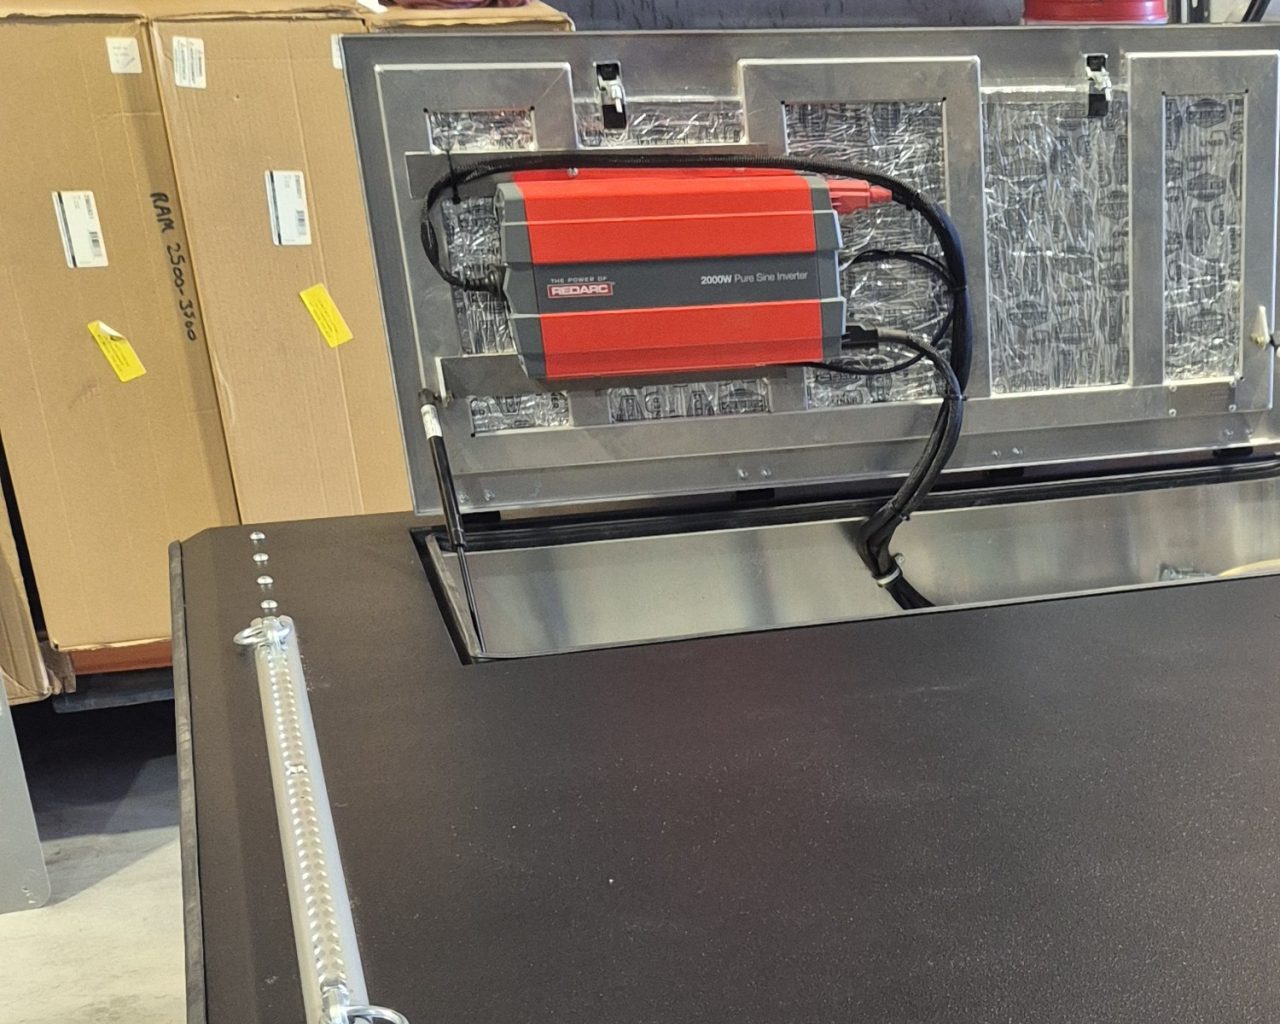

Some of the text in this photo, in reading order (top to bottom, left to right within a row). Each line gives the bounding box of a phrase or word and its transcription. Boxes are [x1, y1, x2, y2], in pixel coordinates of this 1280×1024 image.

[150, 192, 175, 234] RAM
[700, 270, 809, 285] 2000W Pure Sine Inverter
[551, 284, 609, 296] REDARC
